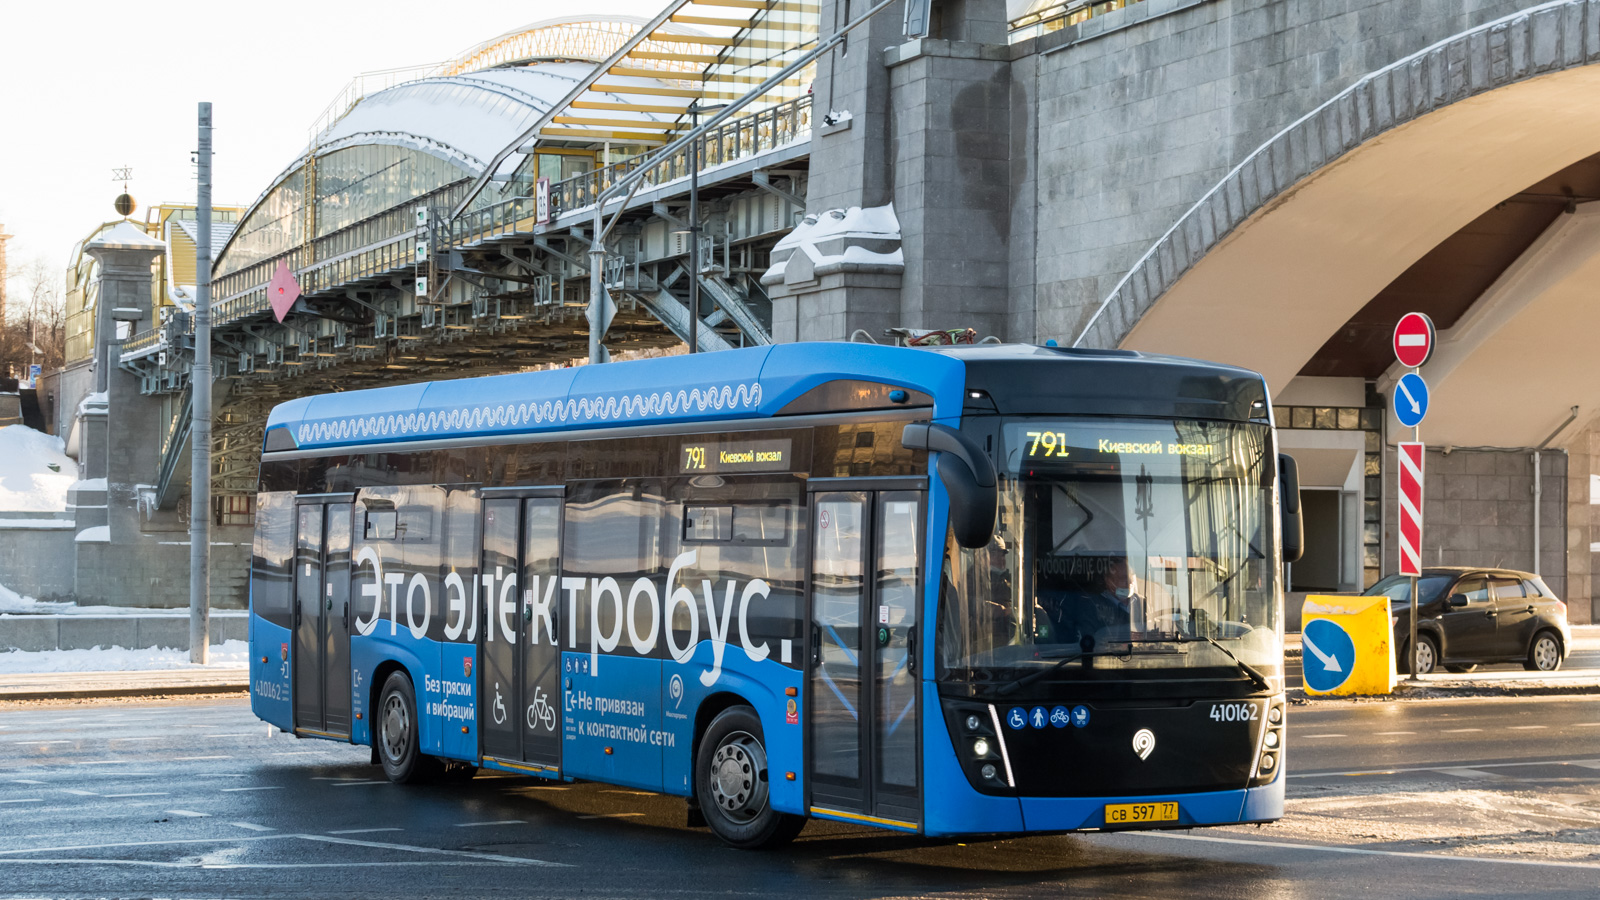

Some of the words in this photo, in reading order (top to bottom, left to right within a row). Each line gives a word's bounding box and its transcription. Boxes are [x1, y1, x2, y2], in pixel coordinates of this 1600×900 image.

[1026, 431, 1070, 457] 791
[1098, 439, 1162, 455] Киевский
[1168, 443, 1213, 456] вокзал
[685, 446, 706, 469] 791
[720, 450, 754, 464] Киевский
[756, 451, 782, 462] вокзал
[355, 546, 432, 640] Это
[443, 549, 792, 687] электробус.
[255, 680, 281, 700] 410162
[425, 674, 441, 693] Без
[441, 680, 472, 698] тряски
[426, 702, 431, 714] и
[432, 698, 475, 722] вибраций
[578, 690, 593, 711] Не
[595, 696, 645, 716] привязан
[1210, 703, 1258, 721] 410162
[578, 721, 585, 735] к
[586, 722, 648, 744] контактной
[649, 729, 675, 747] сети
[1132, 805, 1155, 820] 597
[1162, 803, 1174, 815] 77
